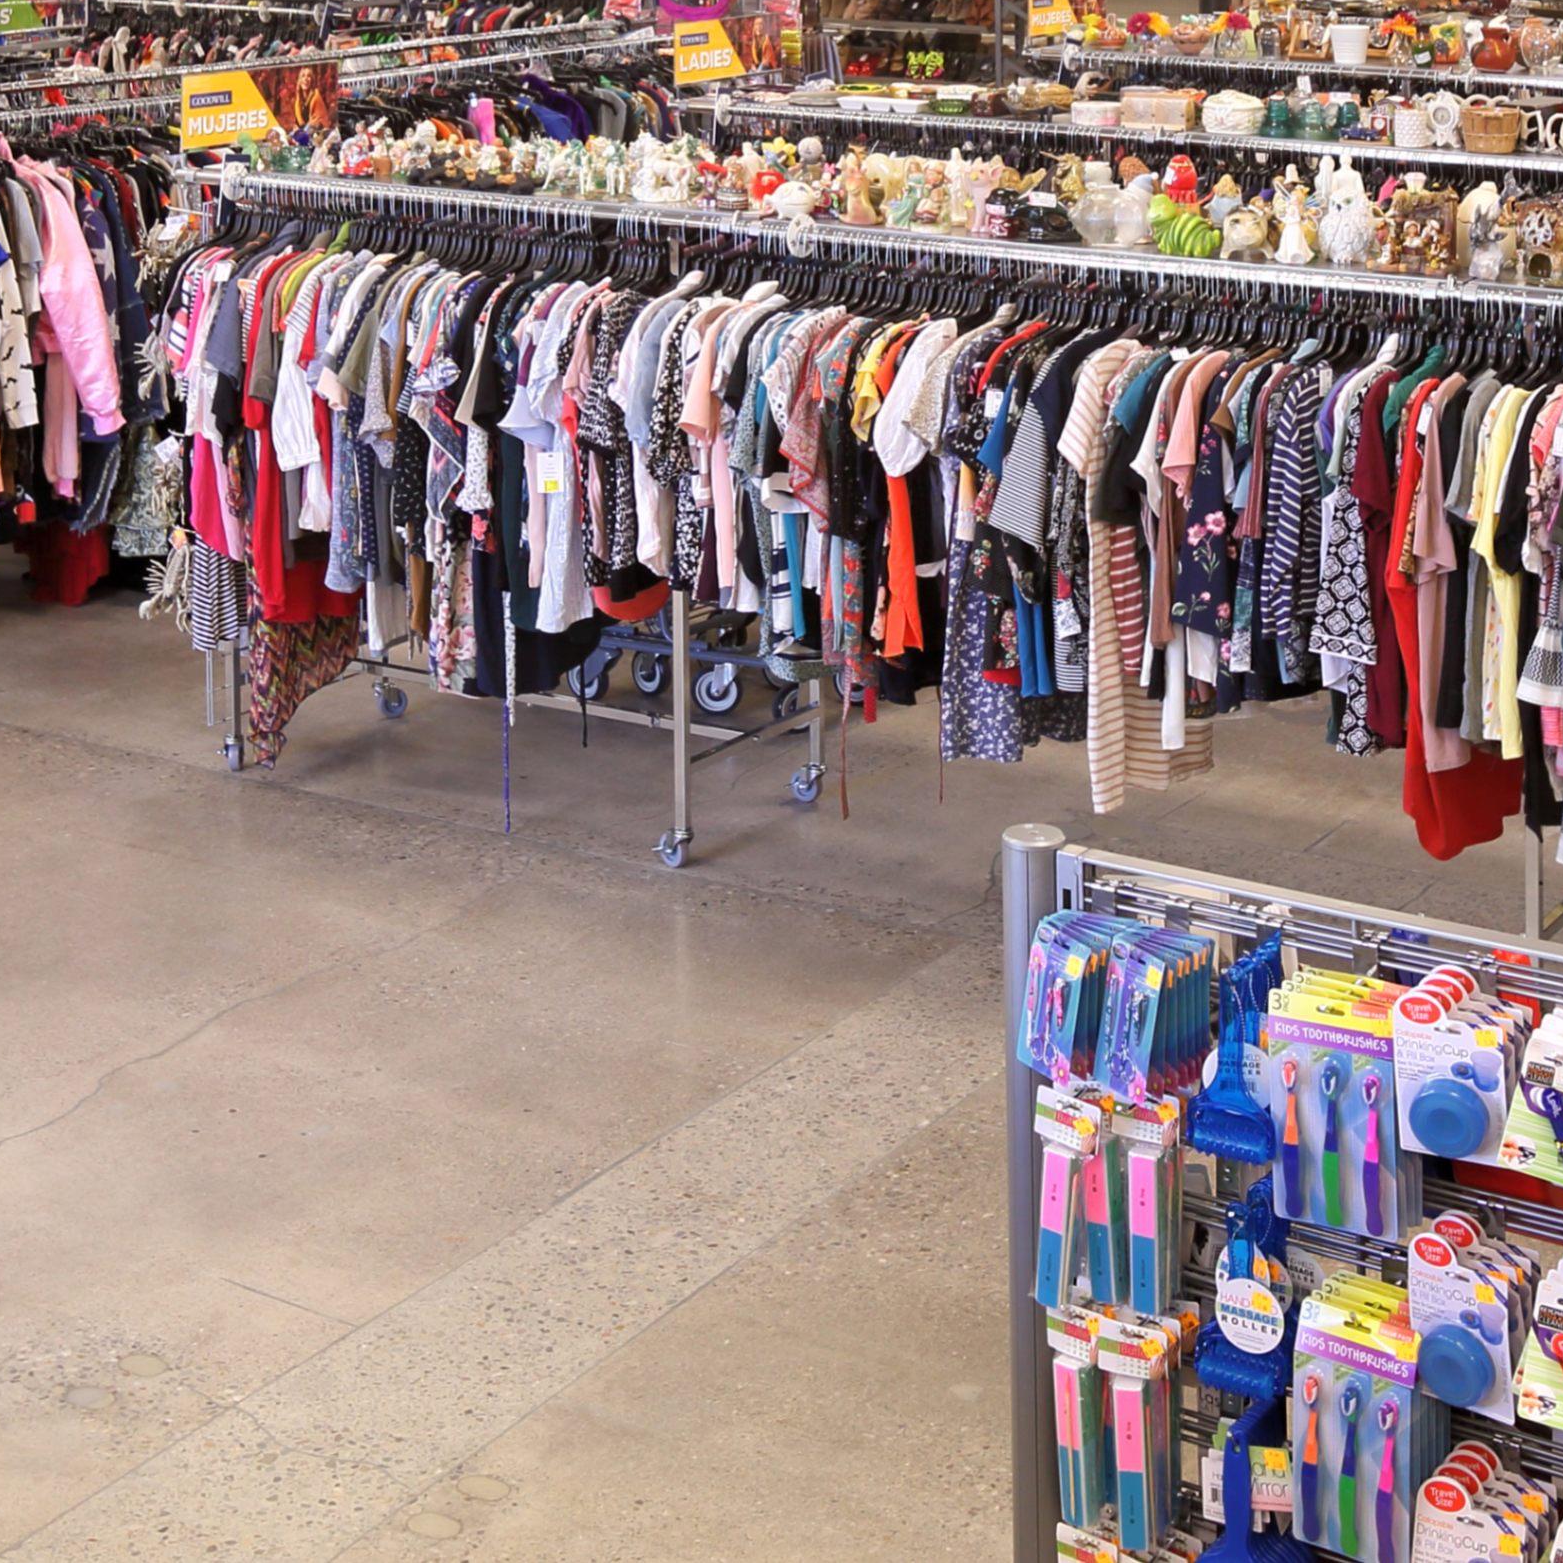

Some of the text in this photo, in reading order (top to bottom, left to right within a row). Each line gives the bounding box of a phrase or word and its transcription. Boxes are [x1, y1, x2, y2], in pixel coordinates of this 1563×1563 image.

[1032, 11, 1074, 27] MUJERES
[191, 93, 230, 107] GOODWILL
[188, 109, 268, 136] MUJERES
[1271, 994, 1282, 1011] 3
[1405, 1002, 1433, 1014] Travel
[1410, 1010, 1430, 1022] Size
[1274, 1021, 1389, 1053] KIDS TOOTHBRUSHES
[1441, 1224, 1466, 1236] Travel
[1419, 1242, 1444, 1256] Travel
[1425, 1250, 1441, 1262] Size
[1220, 1303, 1278, 1327] MASSAGE
[1302, 1304, 1312, 1321] 3
[1220, 1315, 1278, 1336] ROLLER
[1300, 1332, 1409, 1378] KIDS TOOTHBRUSHES
[1429, 1486, 1457, 1500] Travel
[1434, 1496, 1454, 1508] Size
